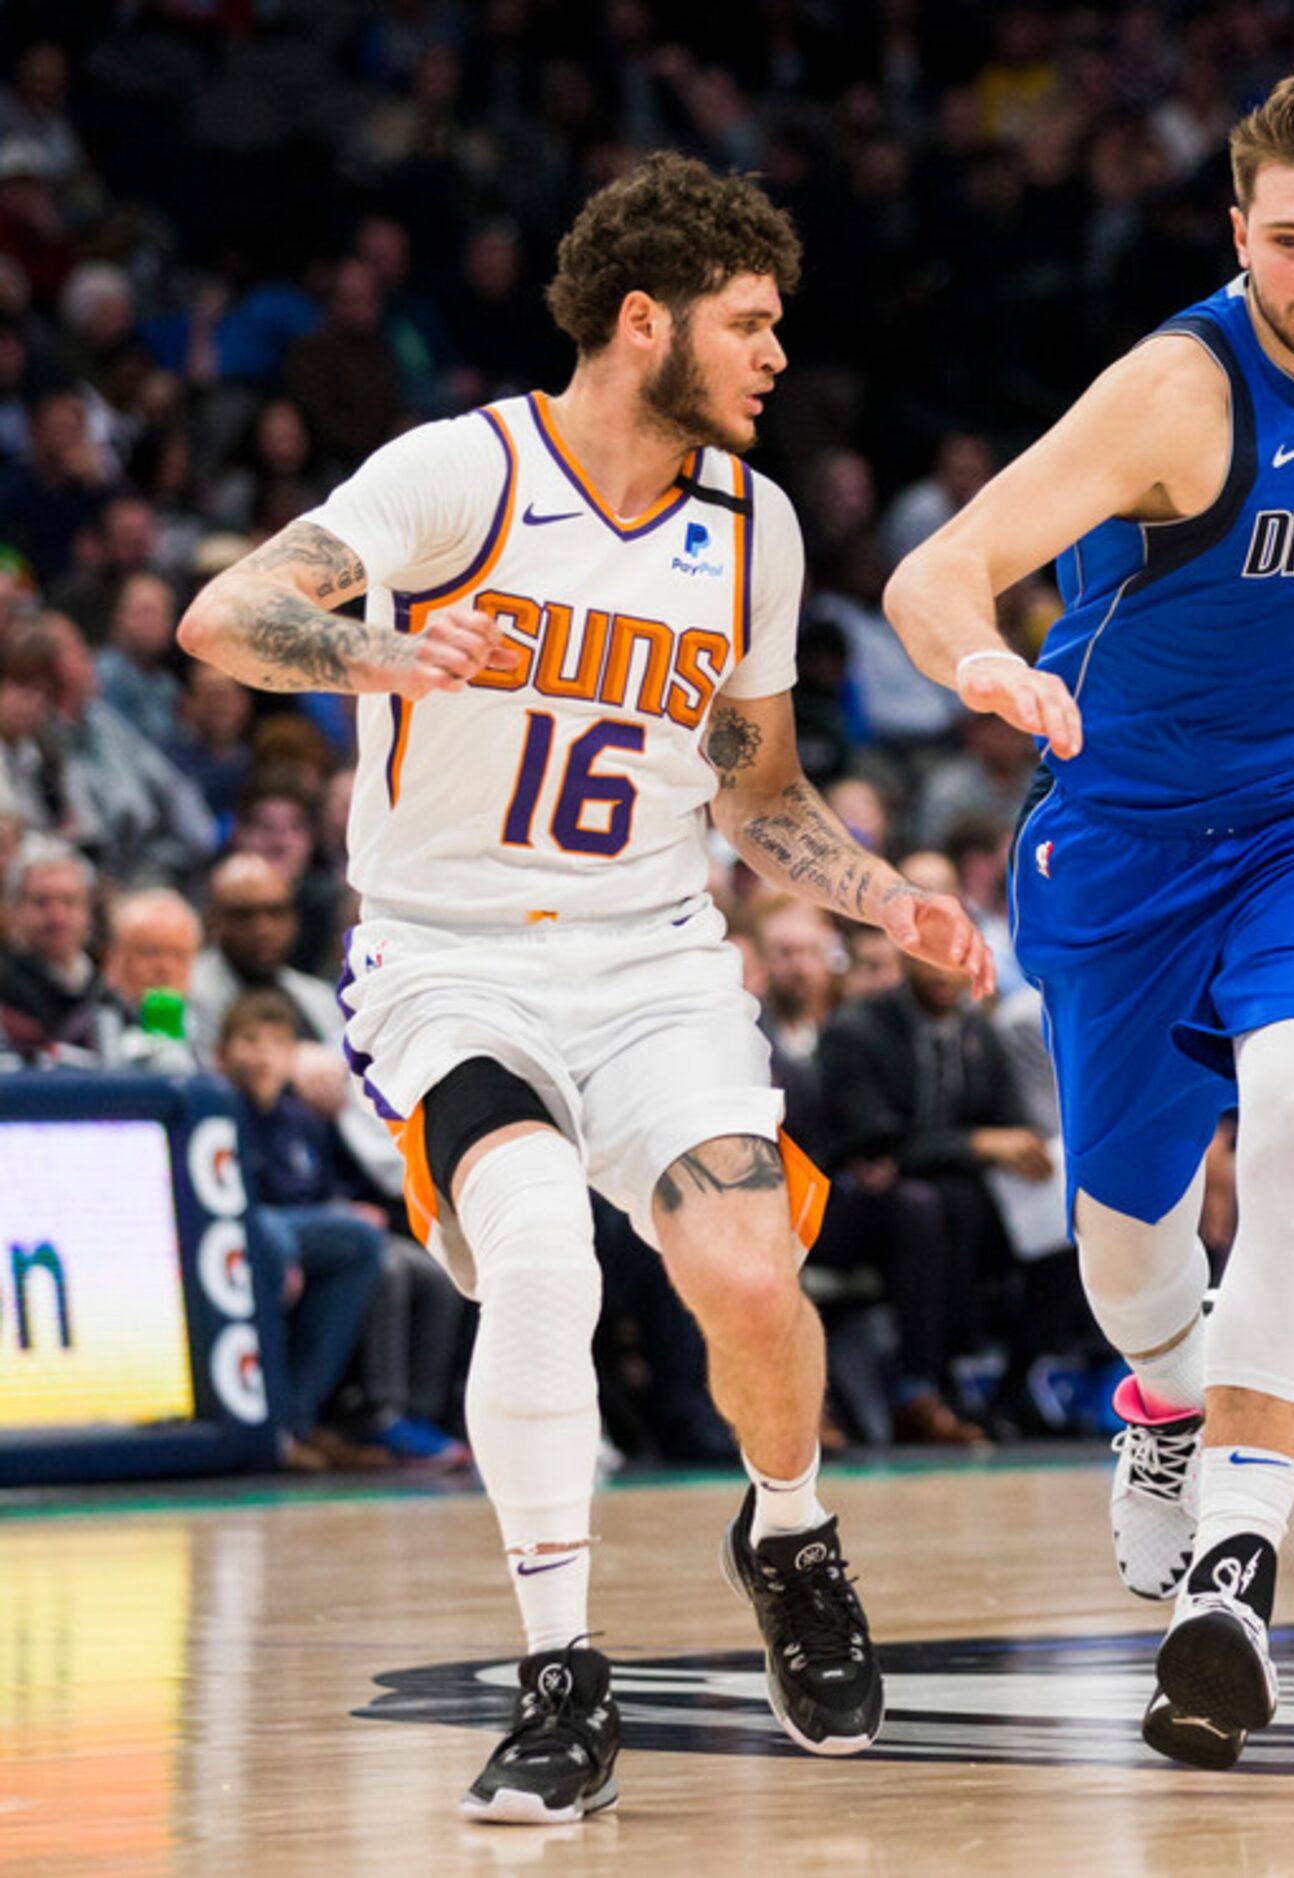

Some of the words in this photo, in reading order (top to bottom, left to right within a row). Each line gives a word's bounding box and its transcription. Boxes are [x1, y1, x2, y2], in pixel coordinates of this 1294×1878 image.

[672, 557, 723, 577] PayPal
[501, 708, 647, 860] 16
[187, 1116, 248, 1218] G
[9, 1240, 71, 1350] n
[196, 1218, 256, 1320] G
[210, 1321, 269, 1425] G
